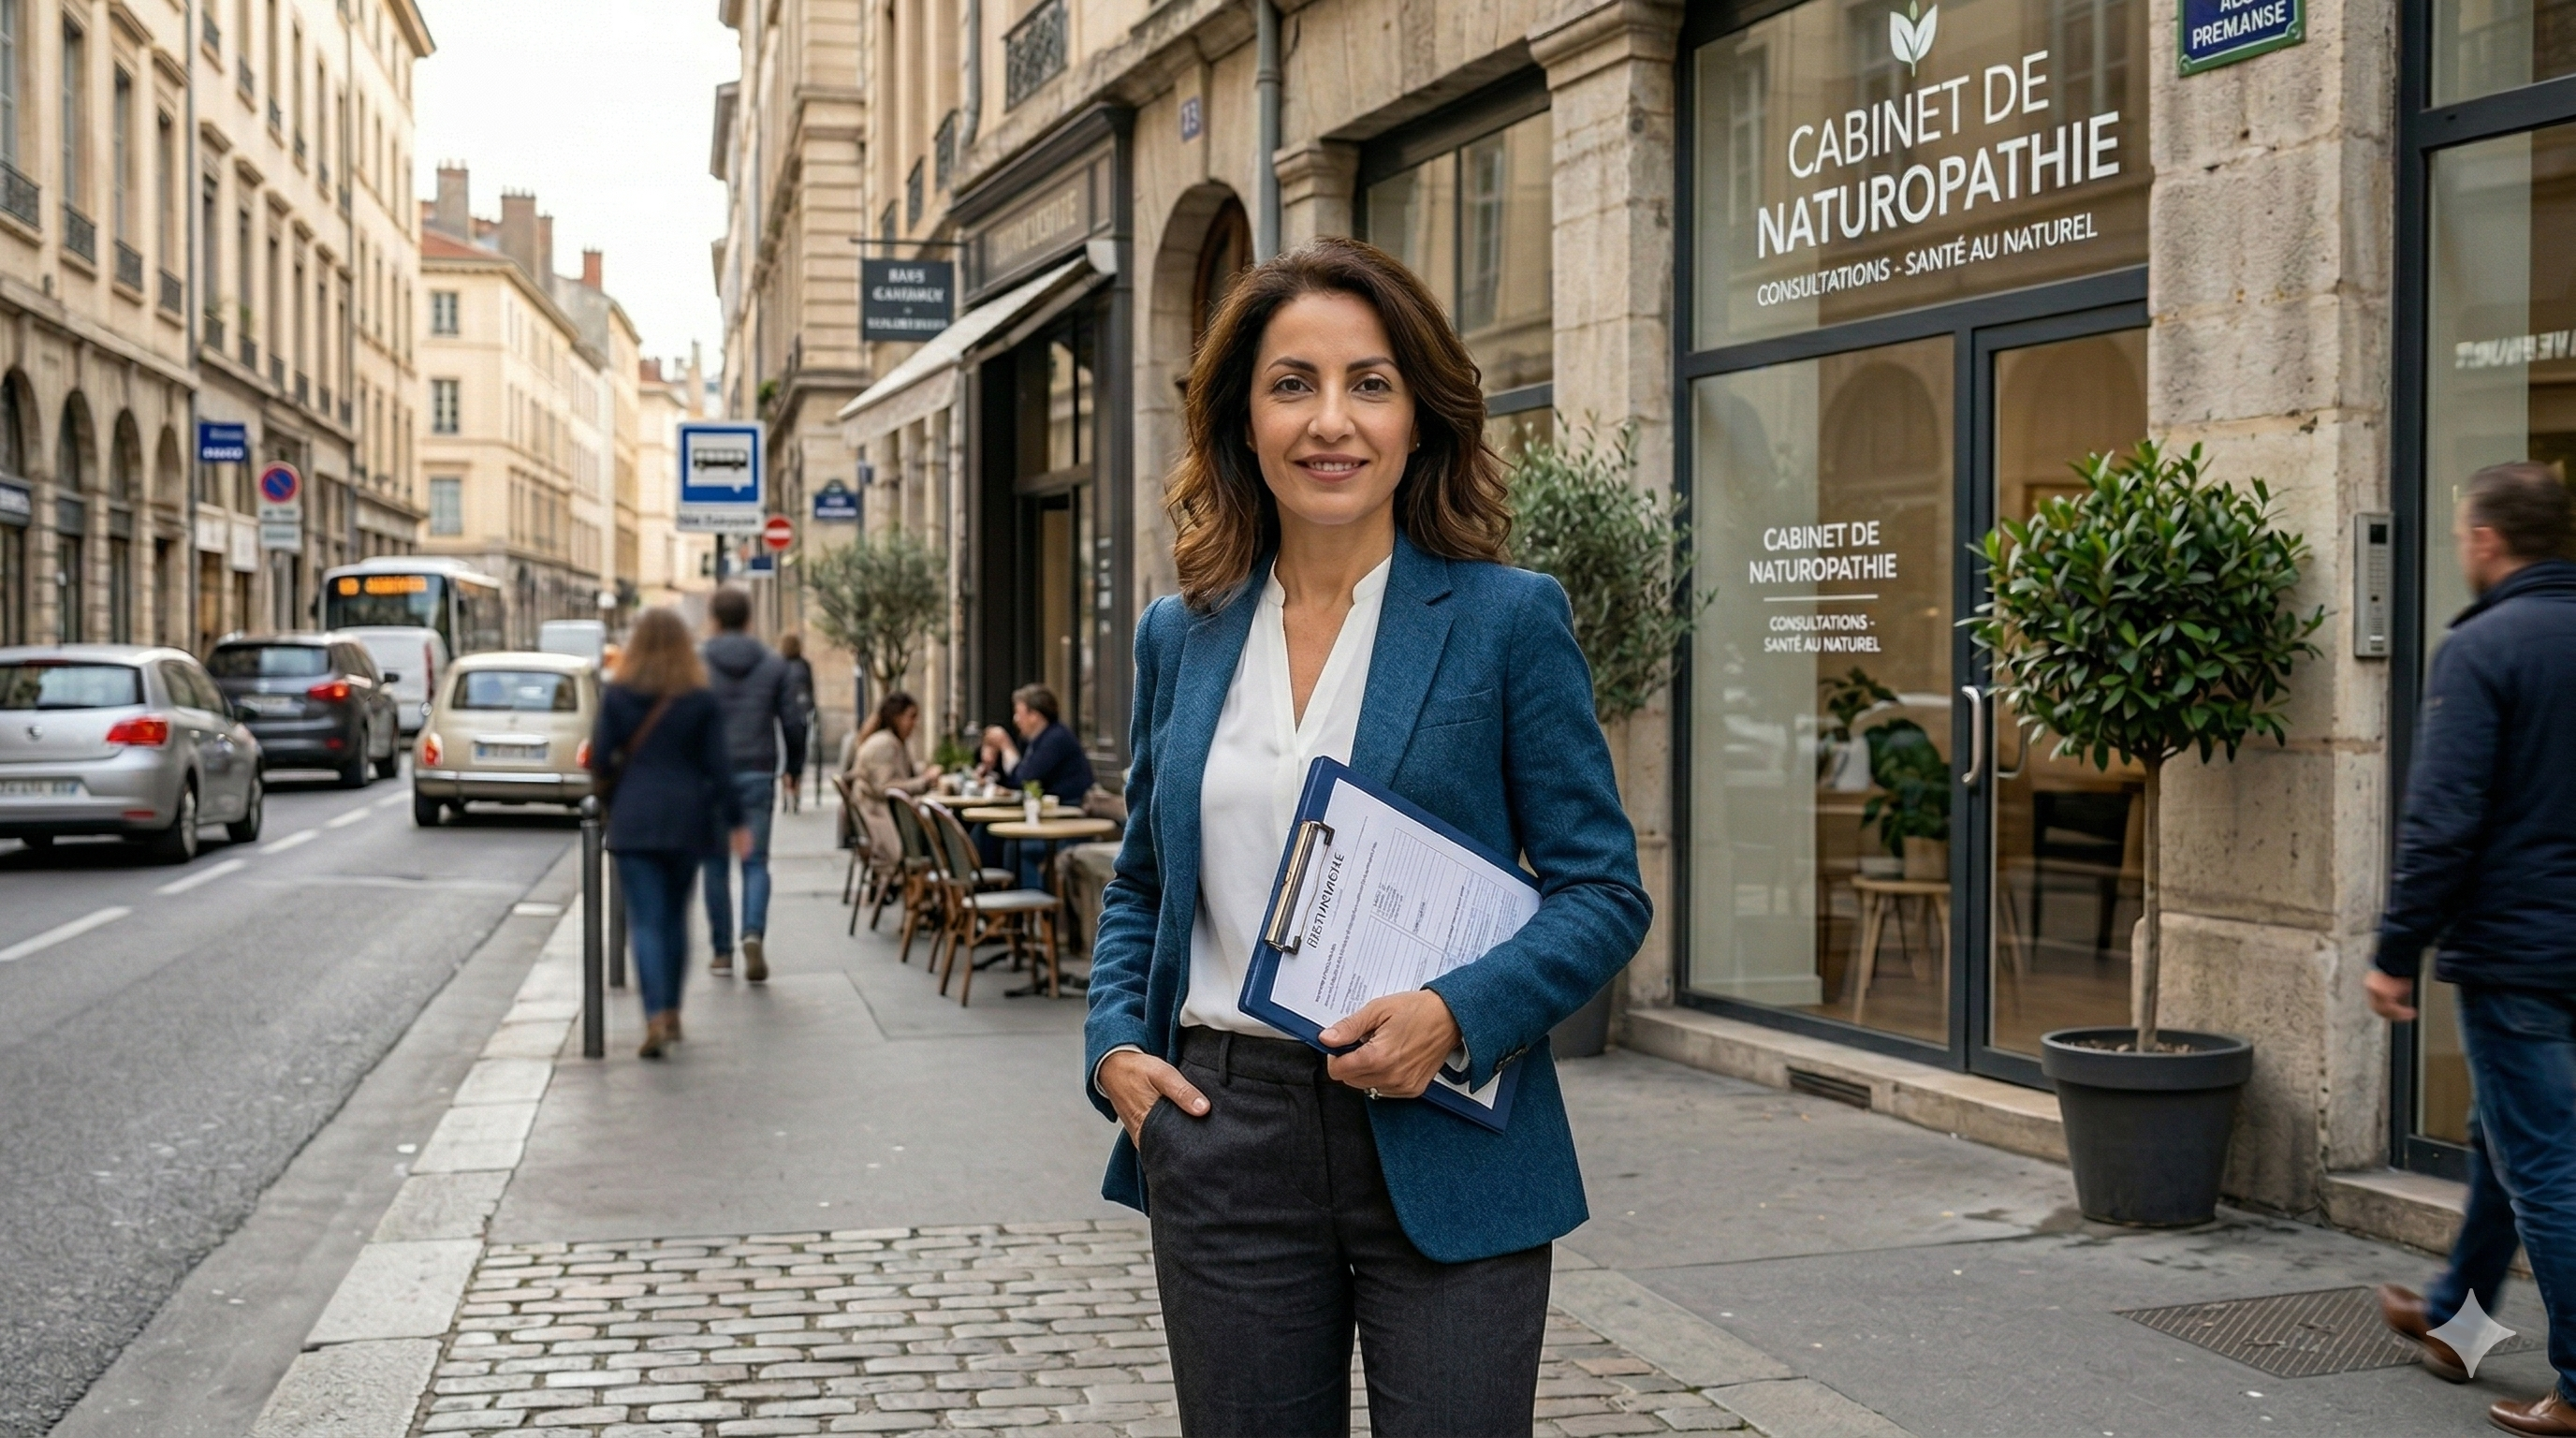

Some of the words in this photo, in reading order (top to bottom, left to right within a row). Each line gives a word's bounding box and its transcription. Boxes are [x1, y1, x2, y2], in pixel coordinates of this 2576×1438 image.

[2192, 1, 2287, 49] PREMANSE
[1789, 74, 1970, 179] CABINET
[1984, 50, 2049, 125] DE
[1758, 110, 2120, 258] NATUROPATHIE
[1757, 257, 1891, 306] CONSULTATIONS
[1905, 234, 1967, 275] SANTÉ
[1969, 232, 1998, 262] AU
[2003, 212, 2098, 255] NATUREL
[1764, 522, 1848, 551] CABINET
[1852, 520, 1881, 547] DE
[1749, 552, 1897, 584] NATUROPATHIE
[1769, 614, 1867, 632] CONSULTATIONS
[1764, 634, 1802, 653] SANTÉ
[1804, 638, 1822, 653] AU
[1823, 637, 1881, 653] NATUREL
